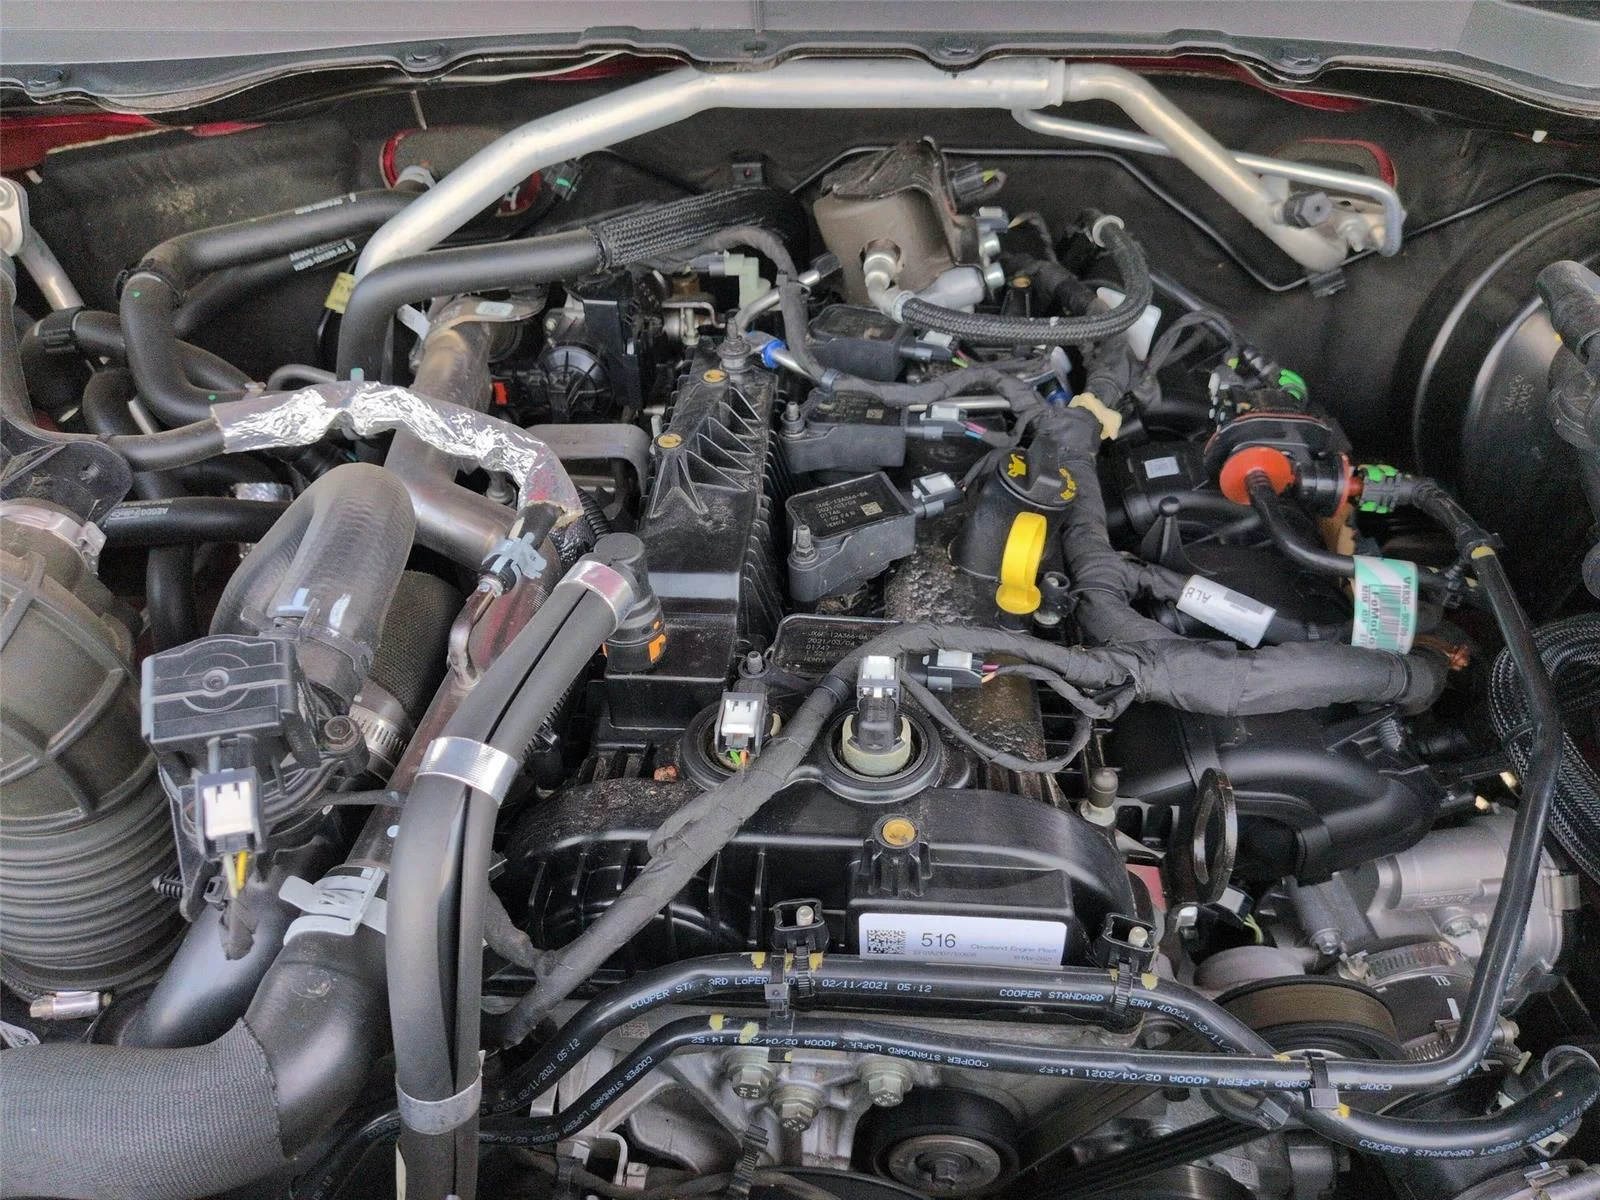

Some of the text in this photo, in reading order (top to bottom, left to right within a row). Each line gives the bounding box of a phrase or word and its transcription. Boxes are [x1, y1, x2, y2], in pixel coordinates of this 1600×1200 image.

[1370, 591, 1380, 644] FoMoCo
[921, 933, 956, 948] 516
[822, 978, 888, 990] 02/11/2021
[896, 983, 932, 993] 05:12
[1430, 975, 1450, 986] TB
[630, 988, 670, 1010] COOPER
[1000, 988, 1042, 998] COOPER
[1048, 991, 1104, 1002] STANDARD
[692, 1036, 724, 1044] 14:52
[804, 1040, 838, 1048] 4000A
[557, 1038, 581, 1062] 05:12
[888, 1048, 941, 1062] STANDARD
[624, 1055, 653, 1081] COOPER
[1085, 1069, 1162, 1082] 02/04/2021
[1168, 1075, 1210, 1084] 4000A
[1217, 1078, 1267, 1088] LoPERM
[591, 1080, 624, 1110] STANDARD
[1359, 1139, 1408, 1155] COOPER
[1414, 1148, 1474, 1158] STANDARD
